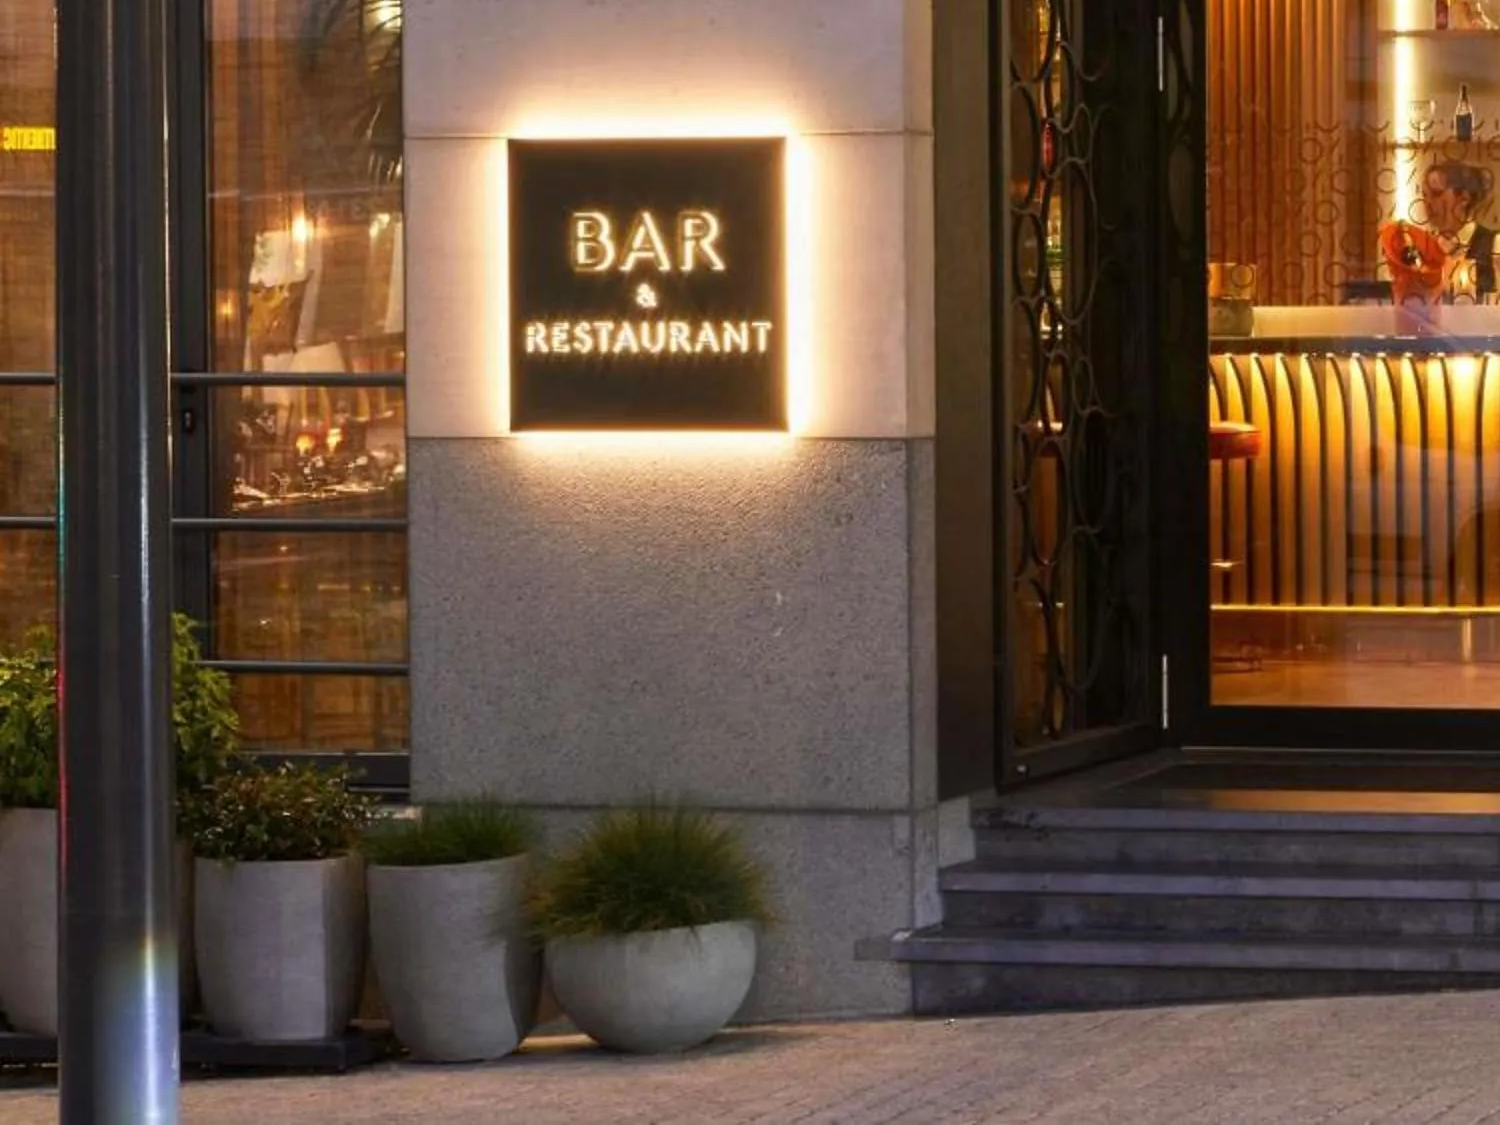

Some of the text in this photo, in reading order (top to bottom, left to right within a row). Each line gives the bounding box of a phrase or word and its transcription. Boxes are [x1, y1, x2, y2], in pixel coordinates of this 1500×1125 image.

[570, 210, 727, 273] BAR
[635, 282, 657, 308] &
[525, 320, 773, 355] RESTAURANT
